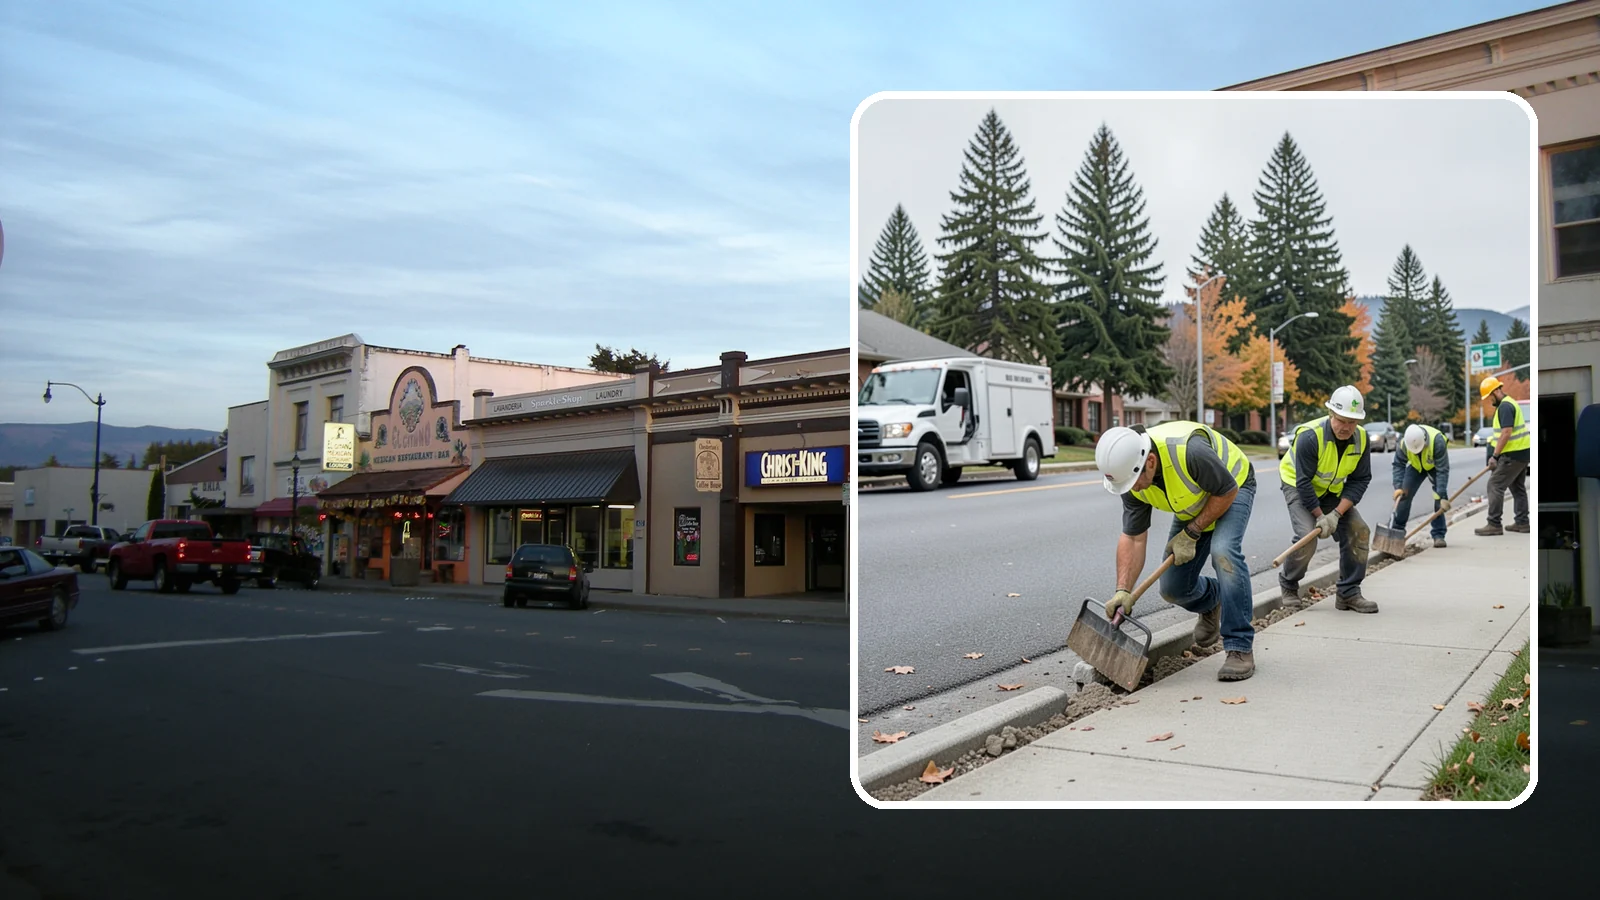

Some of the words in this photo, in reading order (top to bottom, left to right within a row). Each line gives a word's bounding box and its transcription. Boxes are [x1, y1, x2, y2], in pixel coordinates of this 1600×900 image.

[595, 389, 624, 400] LAUNDRY
[493, 402, 523, 413] LAVANDERIA
[530, 396, 560, 409] Sparkle
[561, 394, 582, 405] Shop
[397, 451, 434, 462] RESTAURANT
[438, 450, 450, 459] BAR
[761, 452, 797, 478] CHRIST
[799, 450, 827, 476] KING
